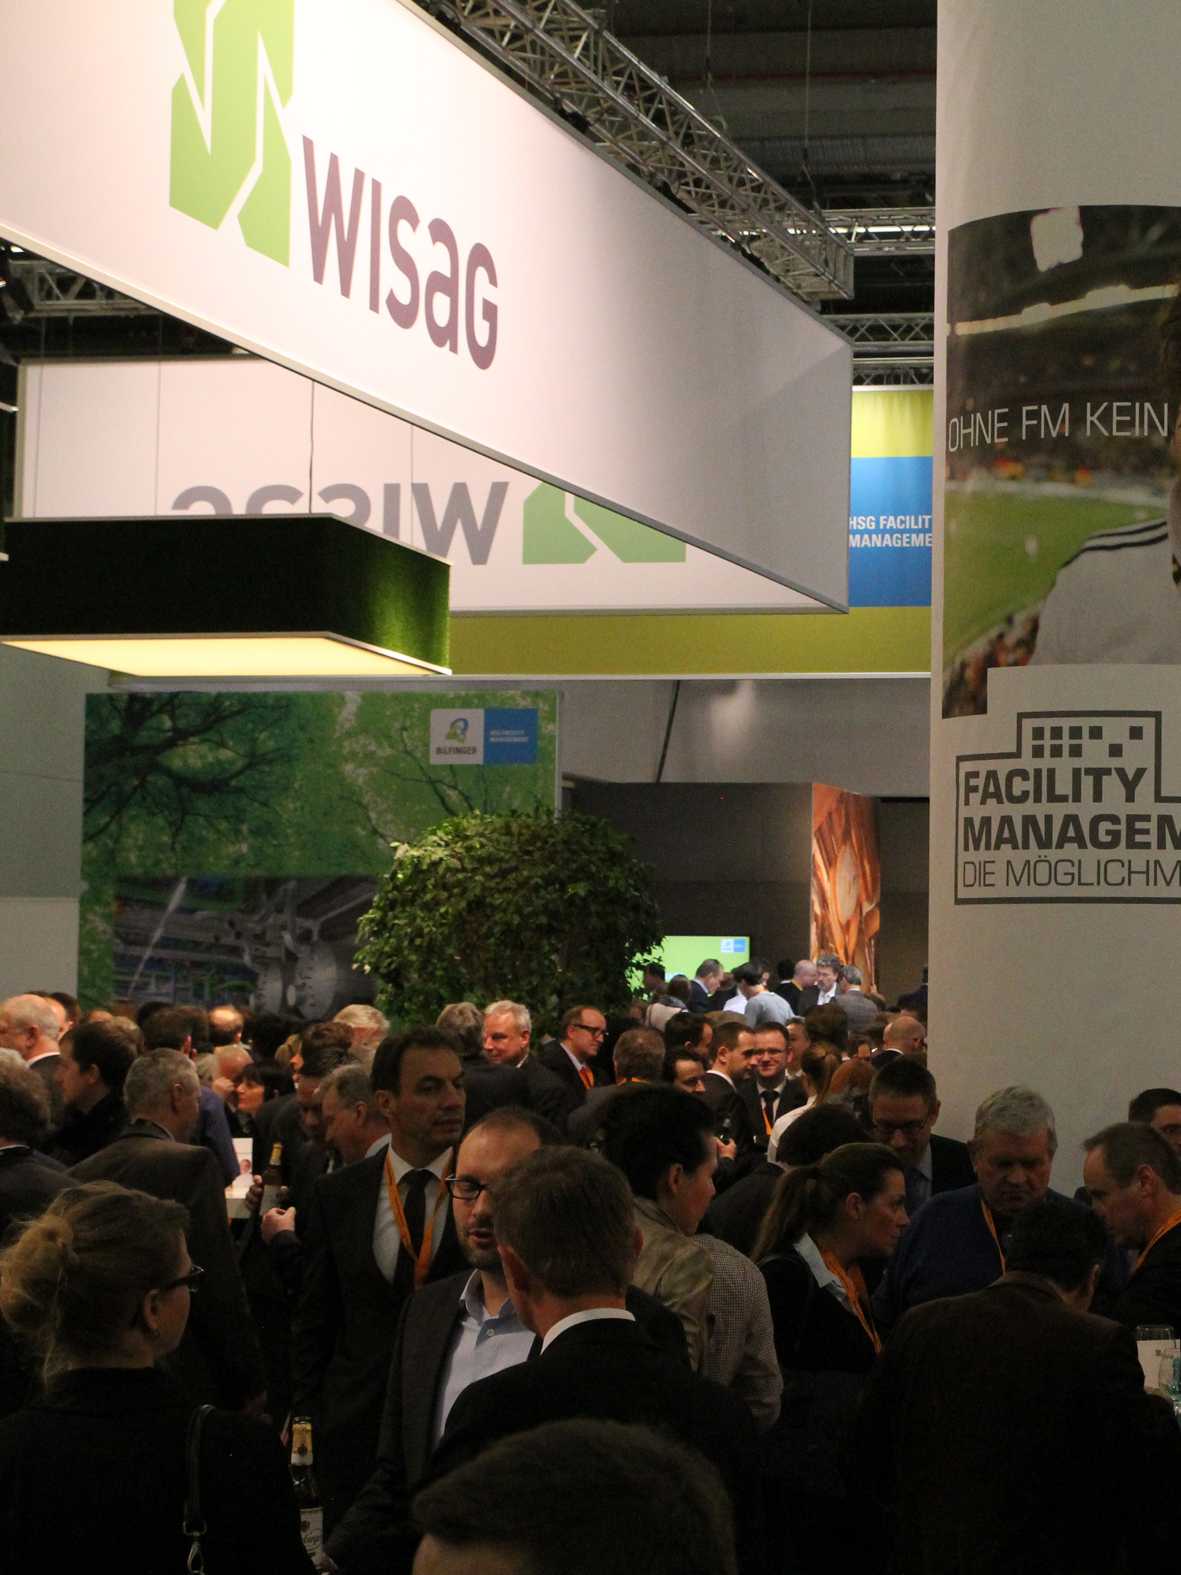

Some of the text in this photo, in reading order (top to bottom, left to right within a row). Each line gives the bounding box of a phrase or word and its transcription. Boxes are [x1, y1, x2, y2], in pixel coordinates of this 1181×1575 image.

[949, 408, 1009, 452] OHNE
[1022, 403, 1069, 440] FM
[1086, 402, 1168, 437] KEIN
[850, 515, 932, 529] HSG FACILIT
[963, 767, 1148, 807] FACILITY
[963, 860, 996, 888] DIE
